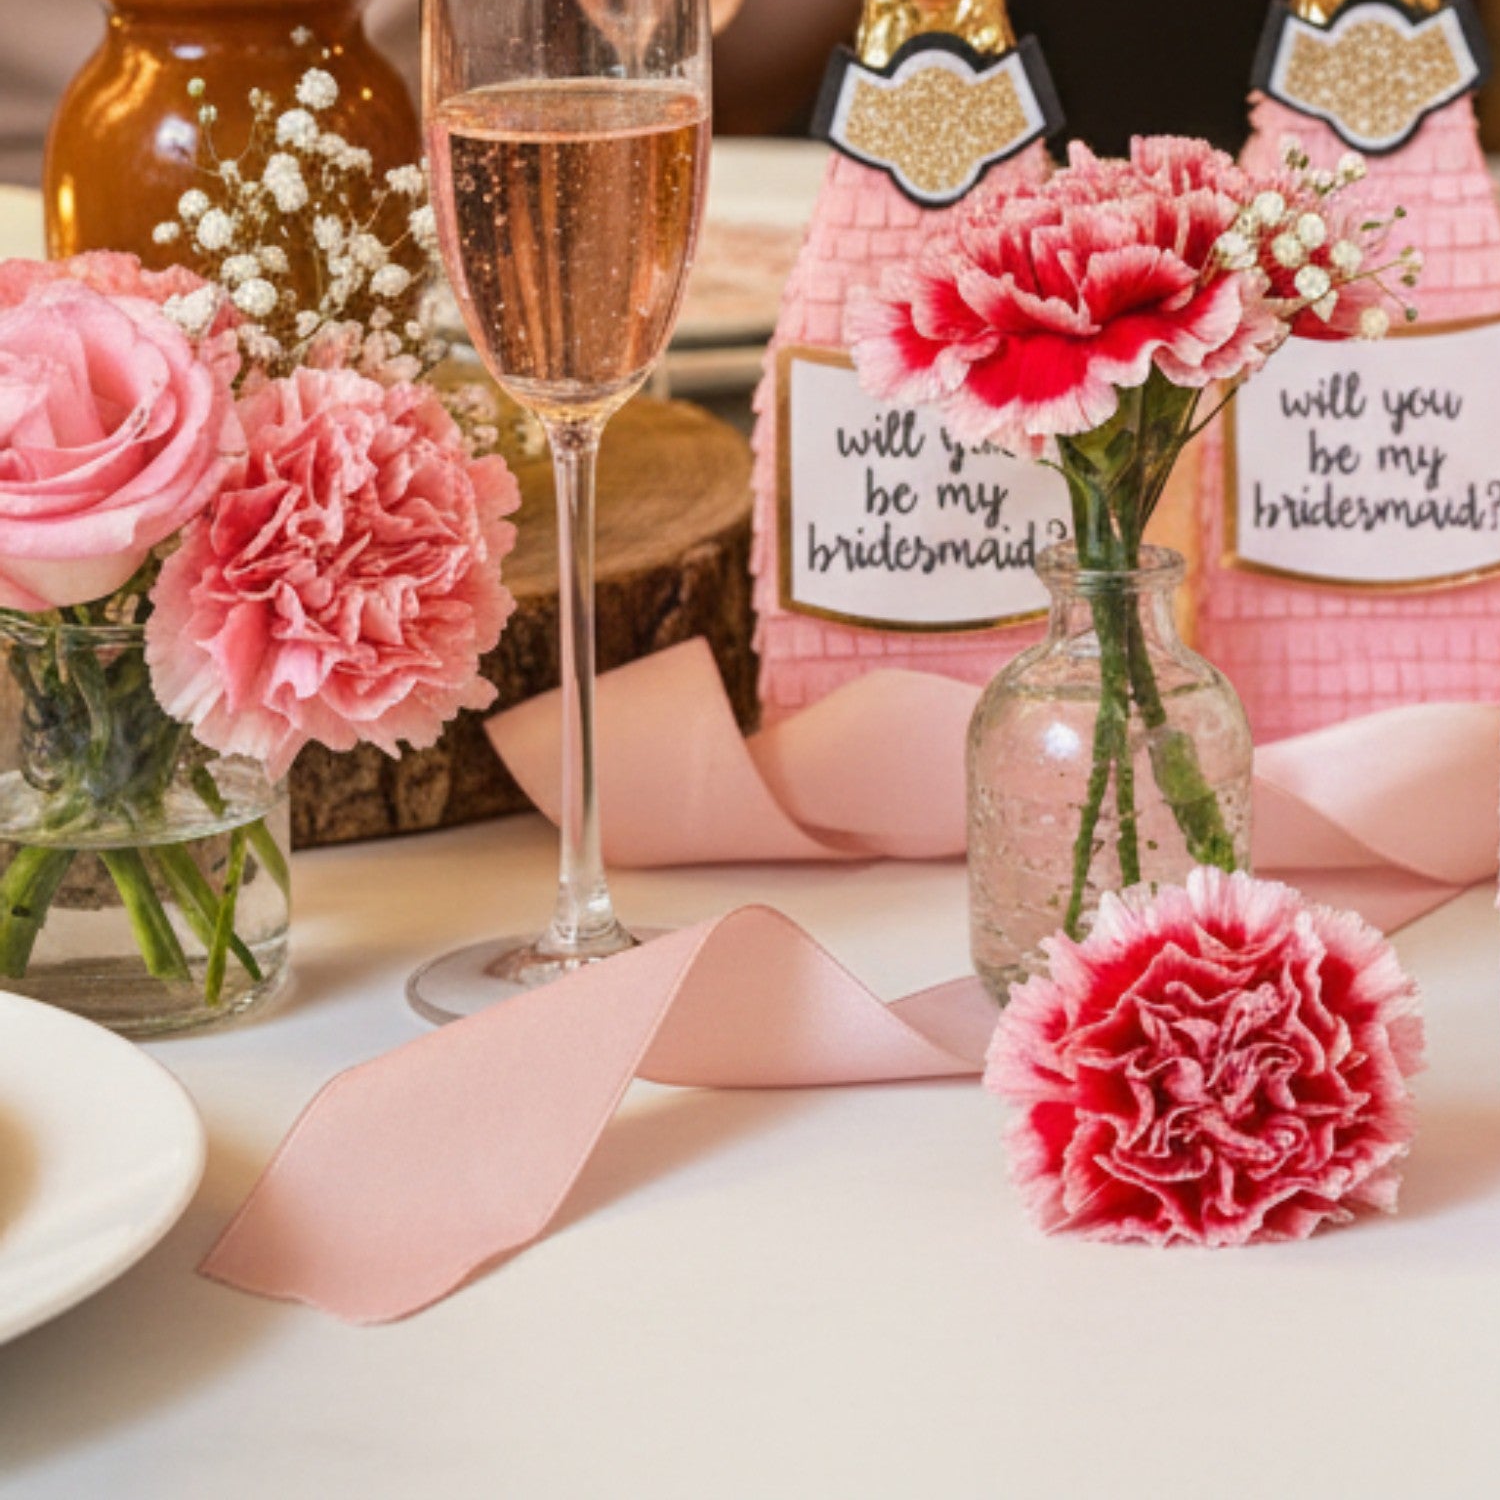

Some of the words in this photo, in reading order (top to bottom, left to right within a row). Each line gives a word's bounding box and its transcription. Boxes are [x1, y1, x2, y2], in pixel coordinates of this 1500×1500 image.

[837, 410, 925, 458] will
[1280, 371, 1366, 420] will
[1381, 387, 1463, 435] you
[1308, 428, 1360, 475] be
[1377, 443, 1447, 491] my
[866, 467, 917, 516] be
[937, 482, 1008, 528] my
